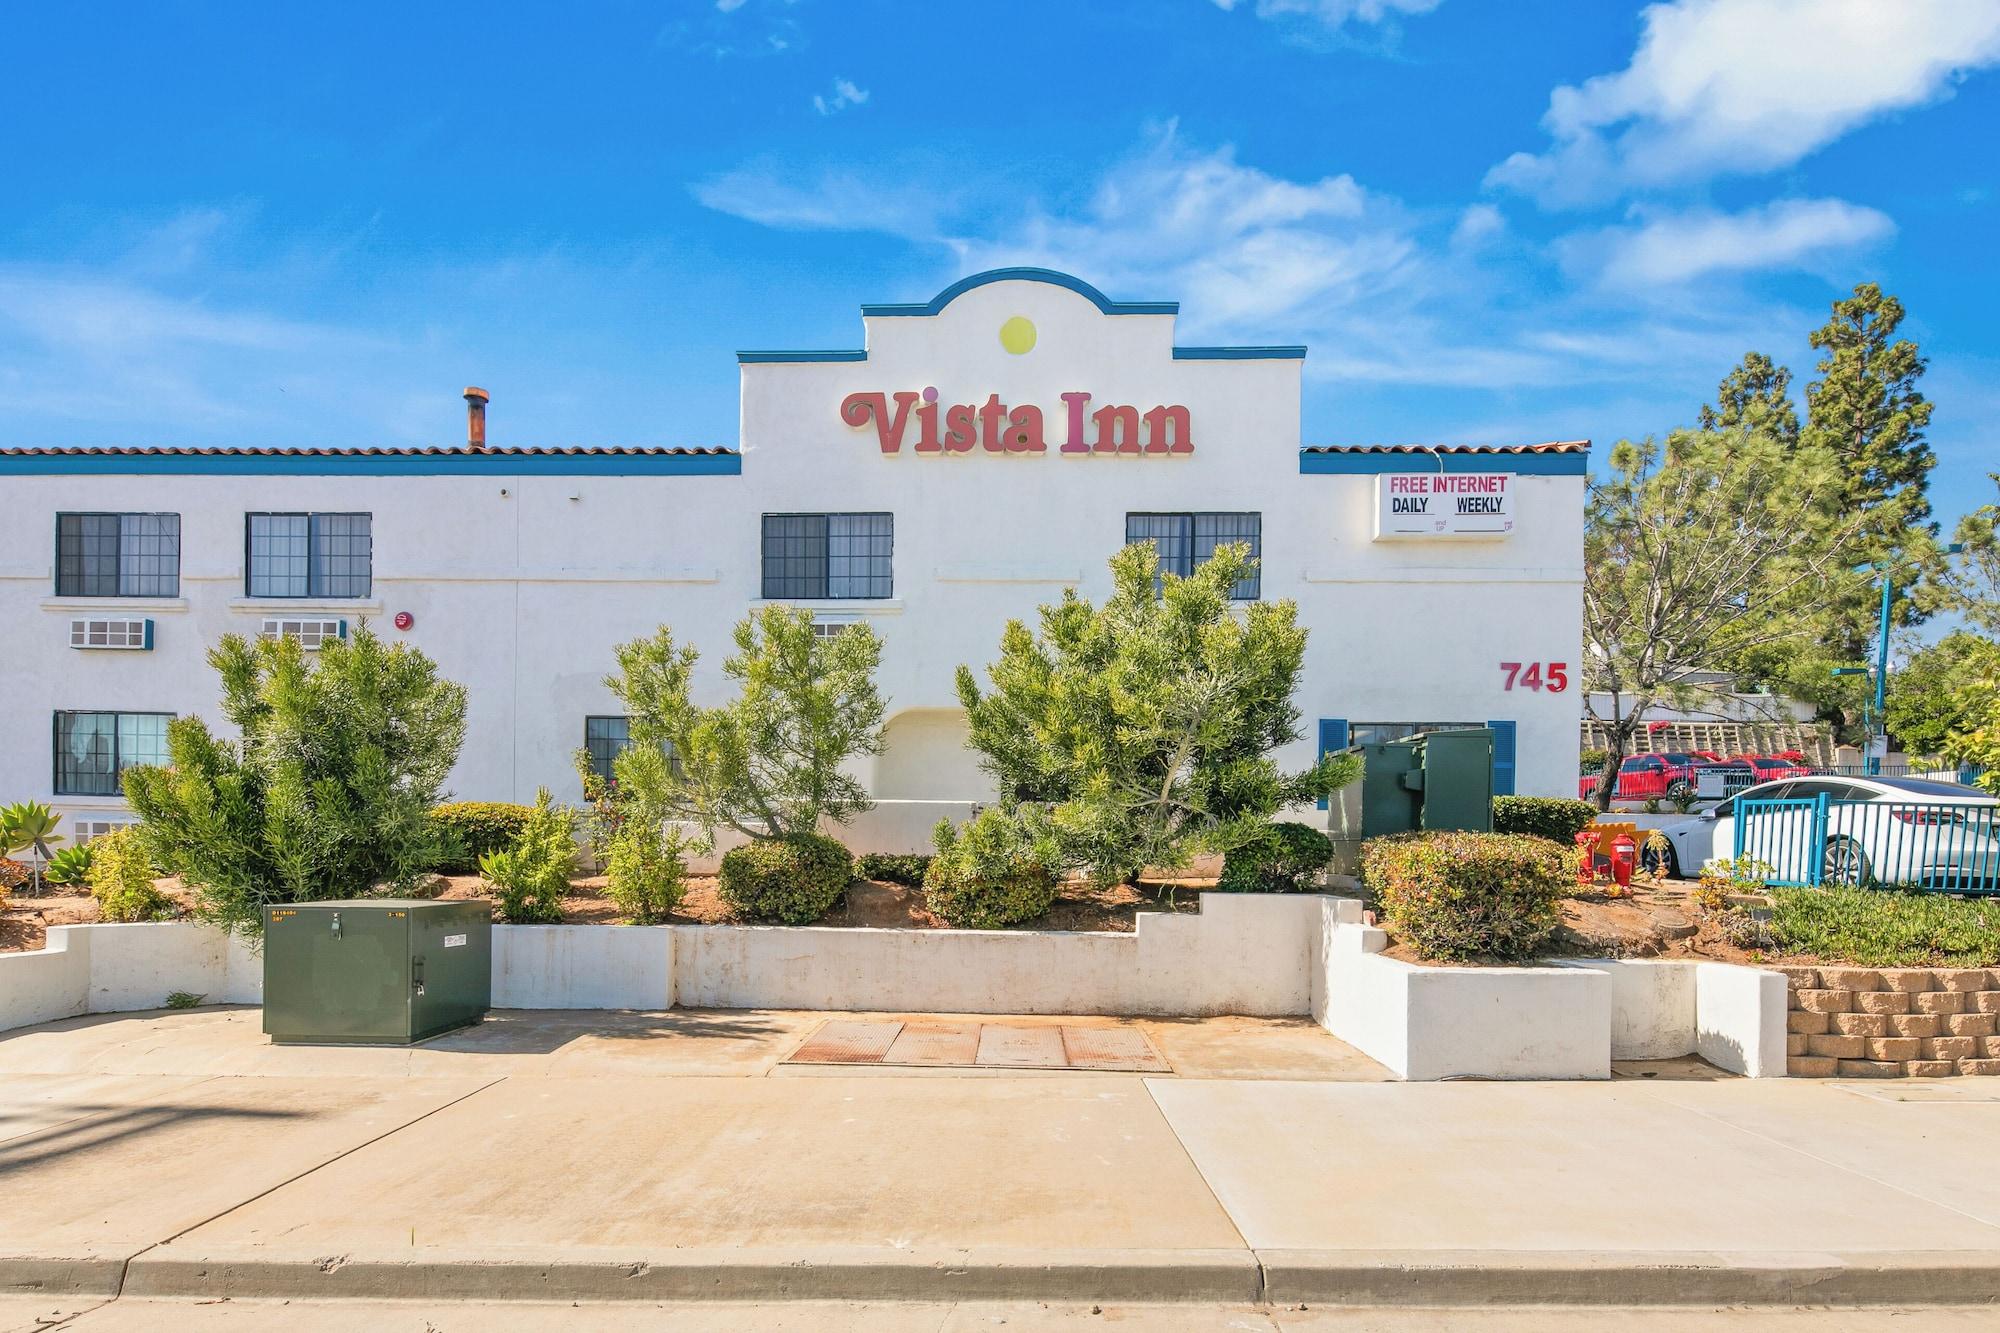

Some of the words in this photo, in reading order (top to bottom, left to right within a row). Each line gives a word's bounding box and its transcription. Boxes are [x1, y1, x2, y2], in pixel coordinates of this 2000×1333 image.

[841, 386, 1047, 455] Vista
[1060, 391, 1195, 455] Inn
[1390, 476, 1428, 493] FREE
[1433, 476, 1508, 493] INTERNET
[1392, 497, 1429, 513] DAILY
[1457, 497, 1503, 513] WEEKLY
[1500, 662, 1568, 693] 745
